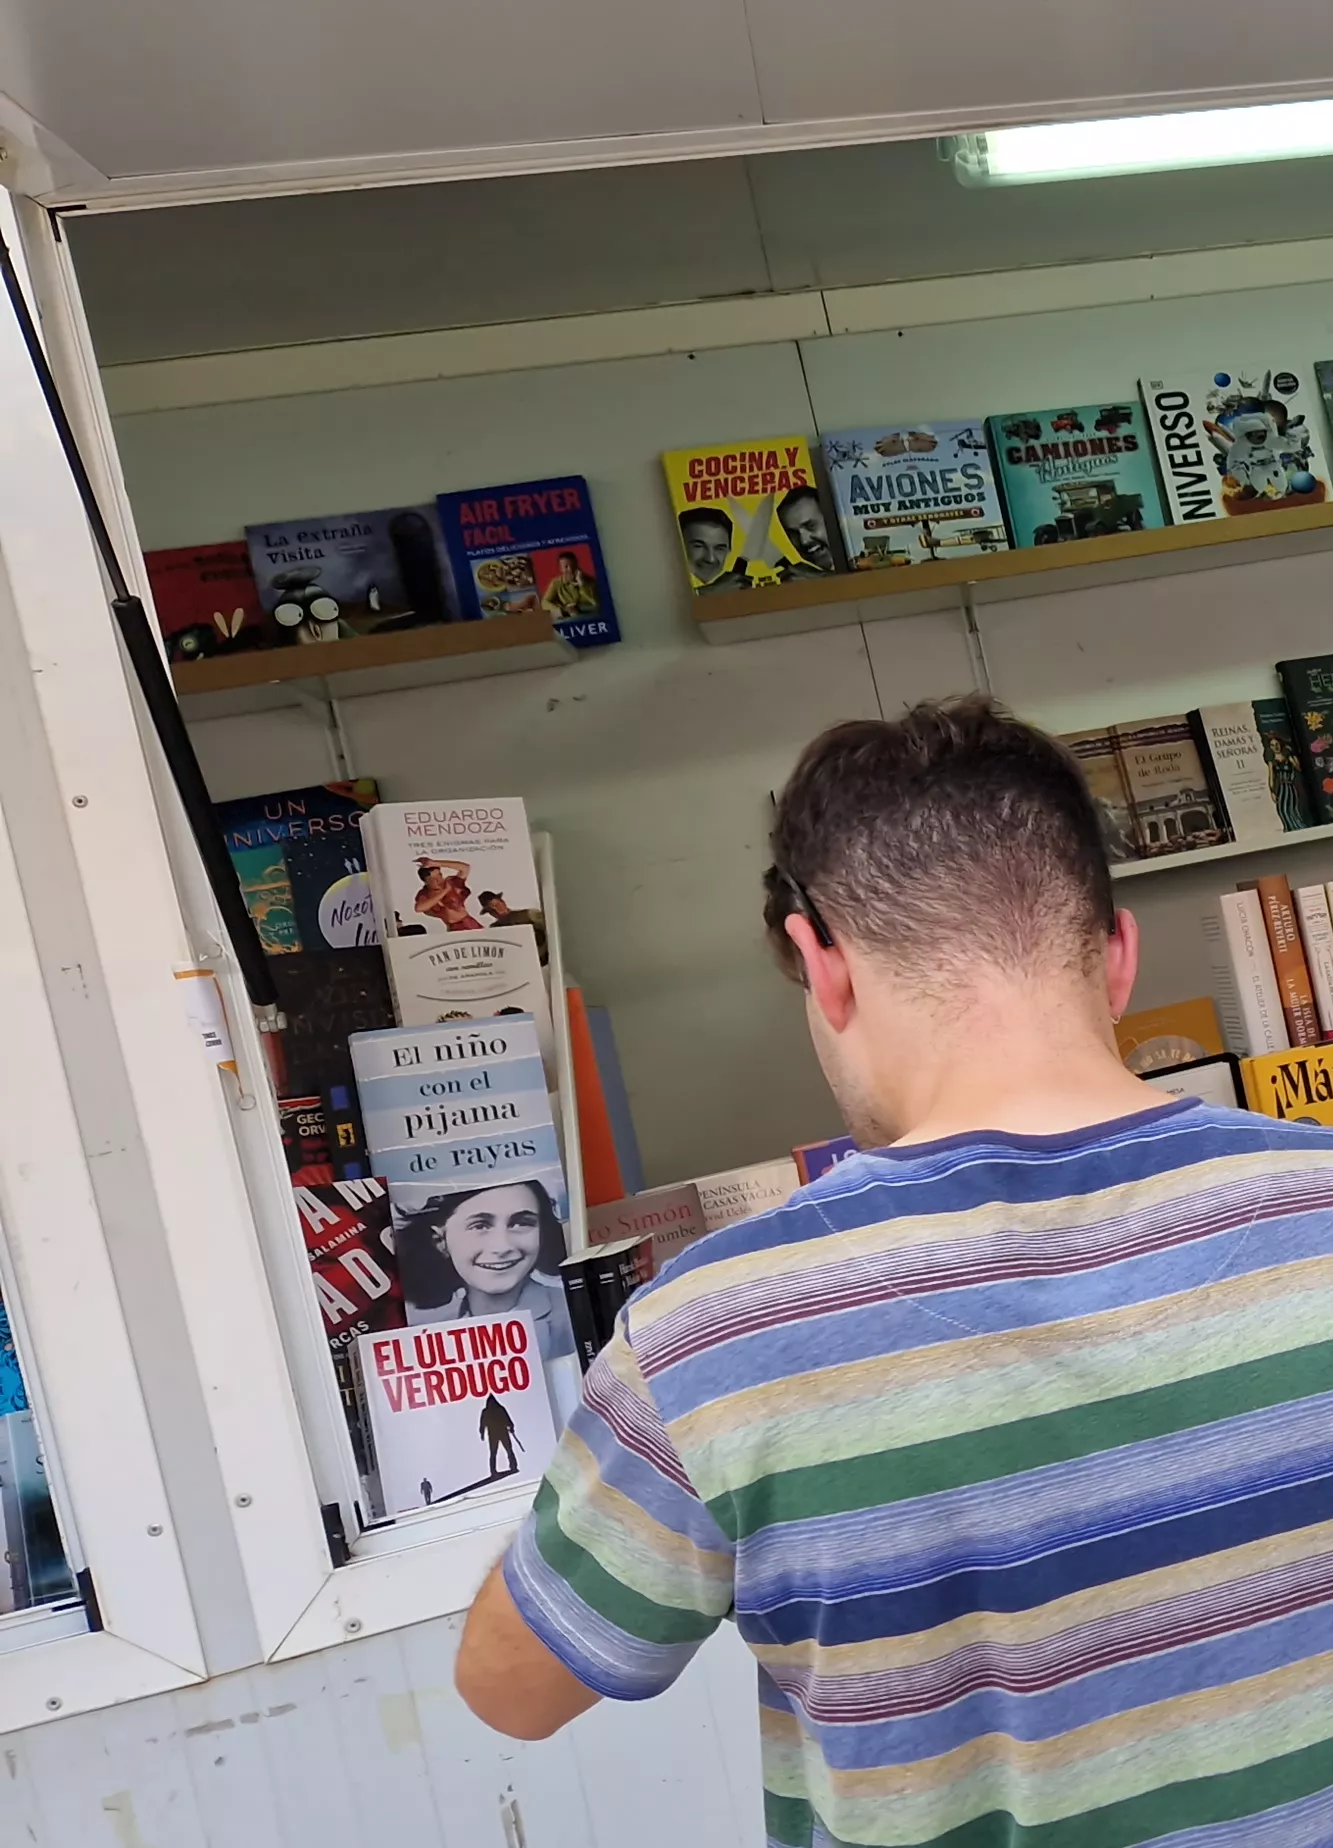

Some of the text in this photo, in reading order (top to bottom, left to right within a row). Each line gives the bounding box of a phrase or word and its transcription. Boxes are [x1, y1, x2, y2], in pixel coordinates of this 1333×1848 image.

[689, 446, 800, 479] COCINA Y
[1006, 434, 1139, 465] CAMIONES
[683, 466, 809, 503] VENCERÁS
[850, 463, 985, 503] AVIONES
[460, 488, 581, 525] AIR FRYER
[852, 492, 986, 516] MUY ANTIGUOS
[264, 534, 289, 548] La
[266, 547, 325, 565] Visita
[1149, 751, 1181, 763] Grupo
[1214, 736, 1247, 749] DAMAS
[264, 800, 306, 820] UN
[404, 808, 504, 825] EDUARDO
[224, 811, 368, 848] NIVERSO
[407, 821, 506, 837] MENDOZA
[1281, 904, 1295, 941] ARTURO
[428, 953, 450, 967] PAN
[453, 948, 468, 960] DE
[1286, 978, 1294, 989] LA
[1288, 992, 1301, 1017] MUJER
[1300, 994, 1317, 1038] LA ISLA DE
[393, 1033, 508, 1068] El niño
[420, 1071, 491, 1097] con el
[404, 1102, 520, 1140] pijama
[410, 1139, 537, 1173] de rayas
[618, 1202, 692, 1235] Simón
[703, 1196, 742, 1210] CASAS
[308, 1221, 368, 1262] SALAMINA
[373, 1320, 528, 1377] EL ÚLTIMO
[382, 1356, 530, 1413] VERDUGO
